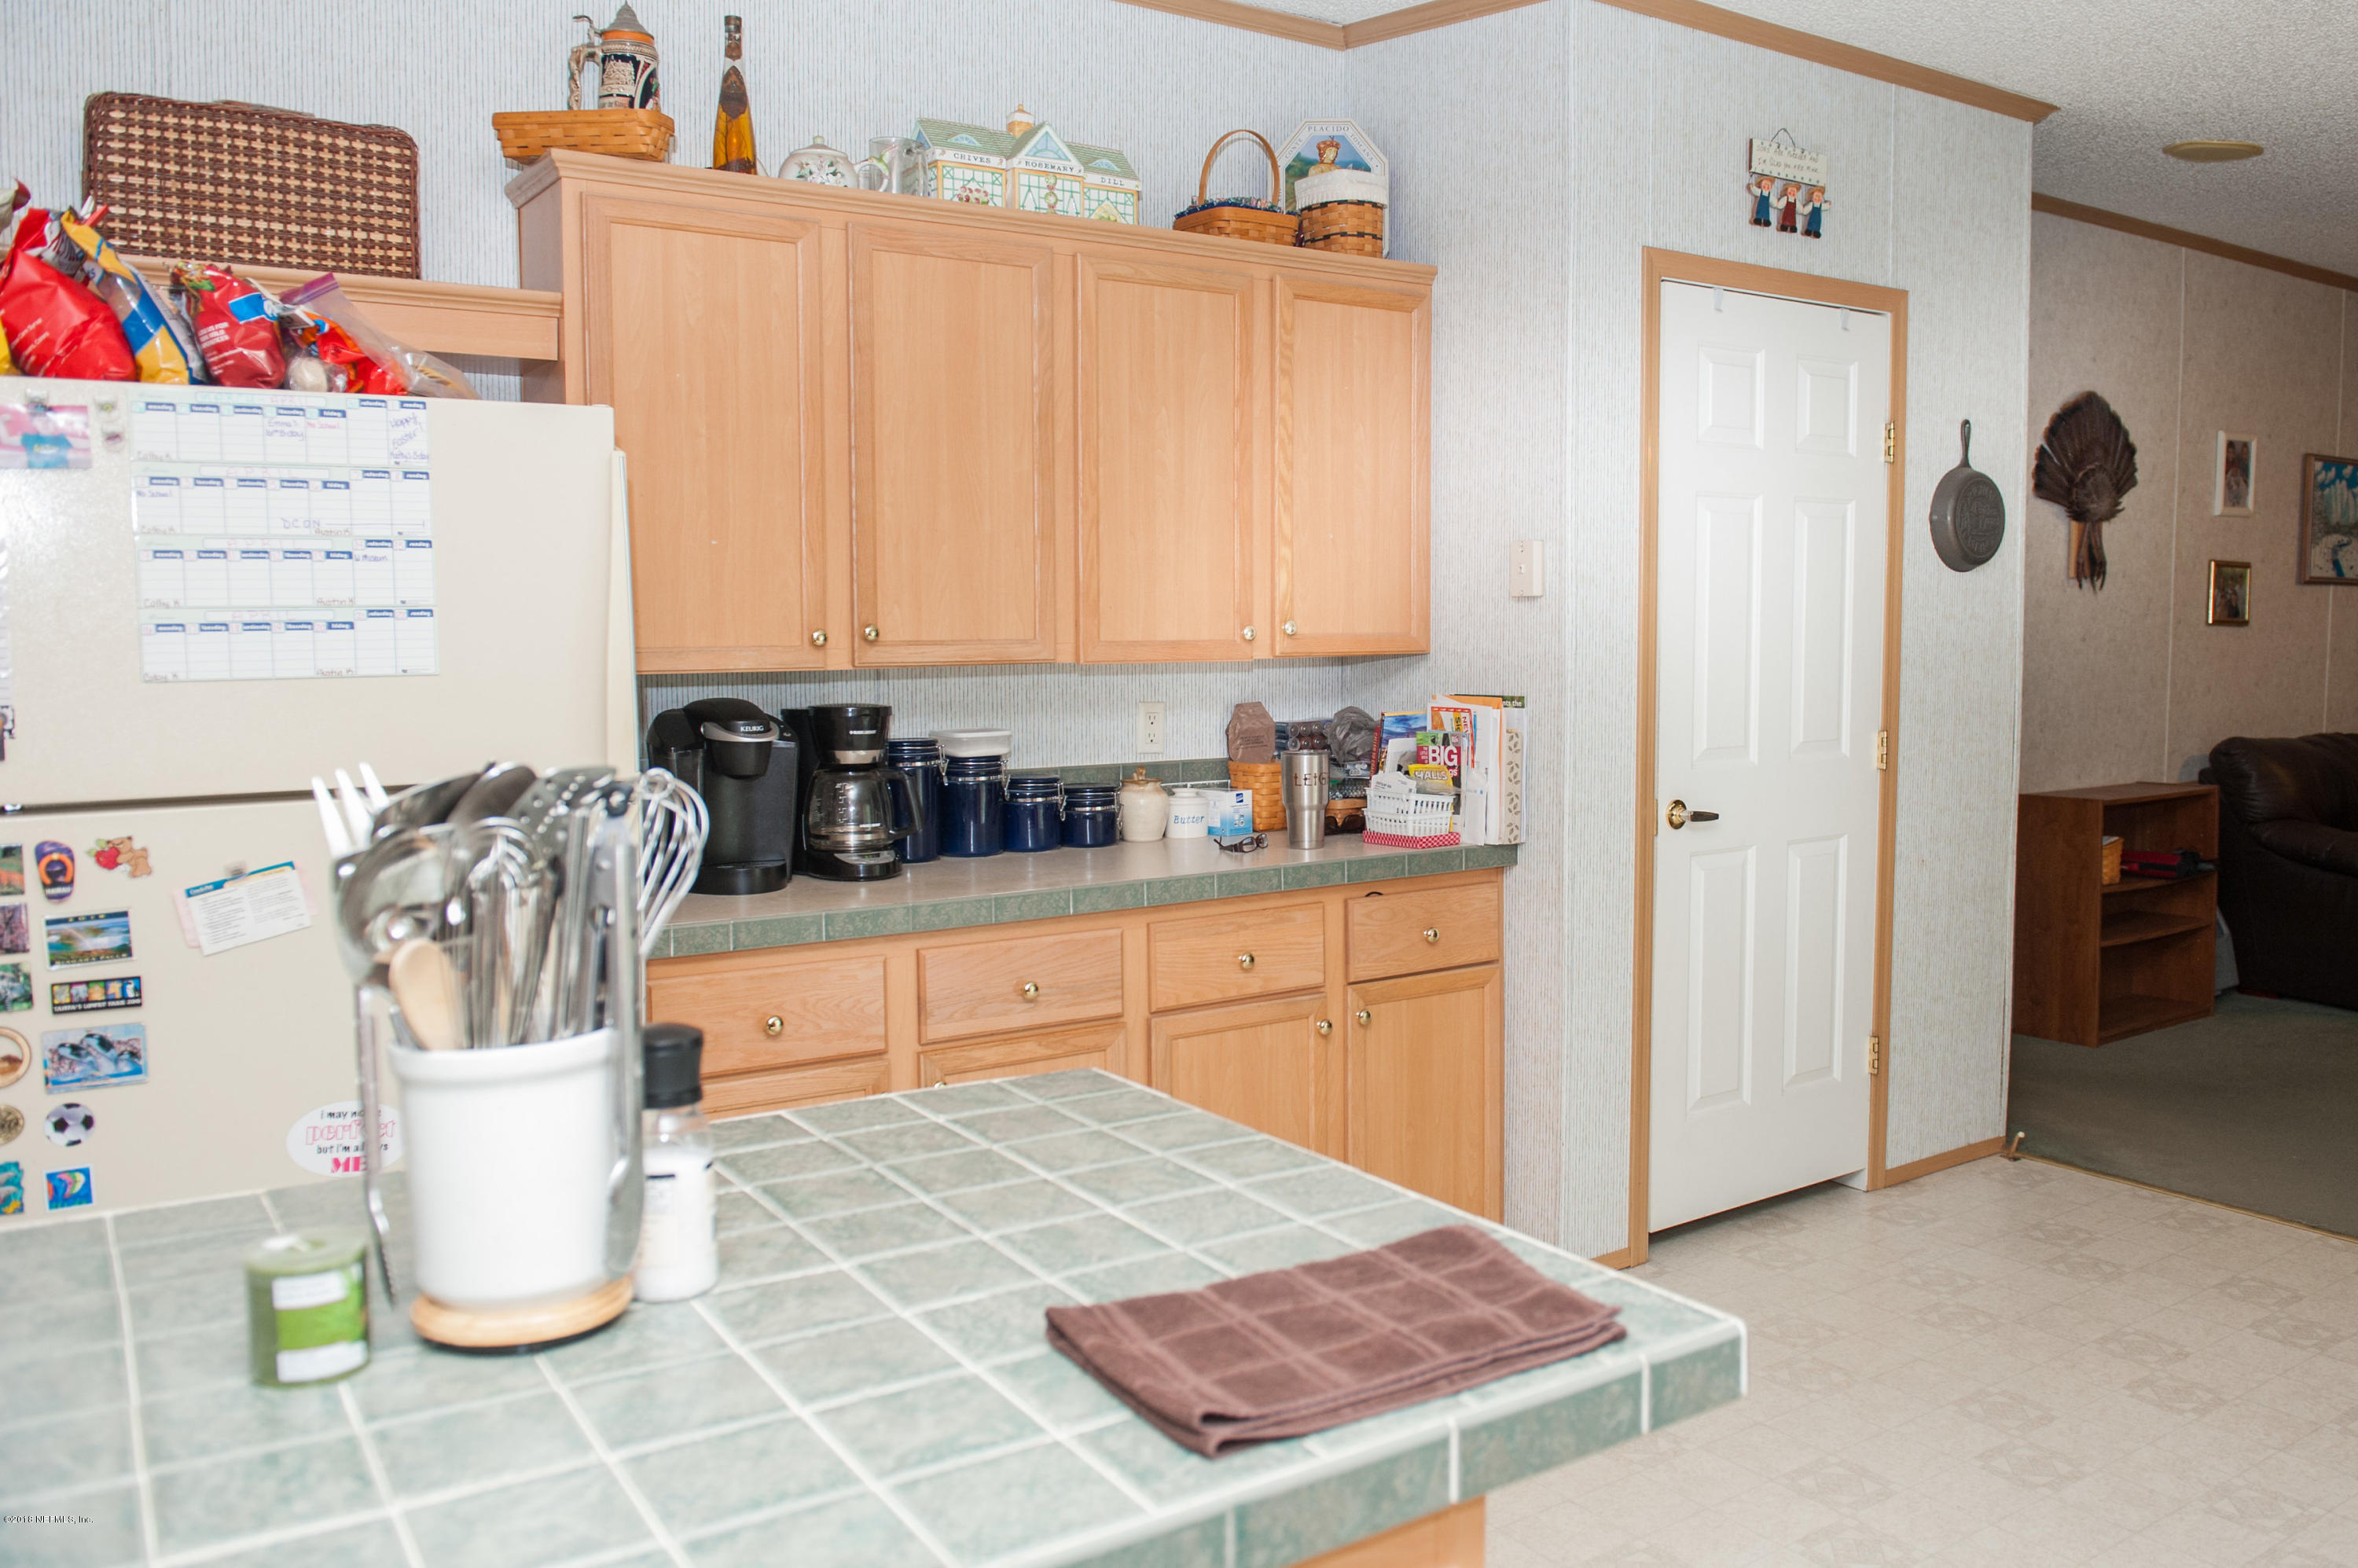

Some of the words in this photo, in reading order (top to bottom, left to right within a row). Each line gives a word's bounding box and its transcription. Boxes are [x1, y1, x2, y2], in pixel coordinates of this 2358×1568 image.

[1285, 138, 1303, 159] CONTE
[1350, 133, 1374, 162] TOSCANA
[953, 152, 991, 164] CHIVES
[1025, 160, 1074, 172] ROSEMARY
[1101, 176, 1125, 186] DILL
[1429, 745, 1458, 766] BIG
[1415, 769, 1448, 780] HALLS
[1173, 814, 1205, 824] Butter
[326, 1111, 347, 1120] may
[306, 1119, 396, 1145] perfct
[317, 1144, 333, 1154] but
[331, 1155, 367, 1173] ME
